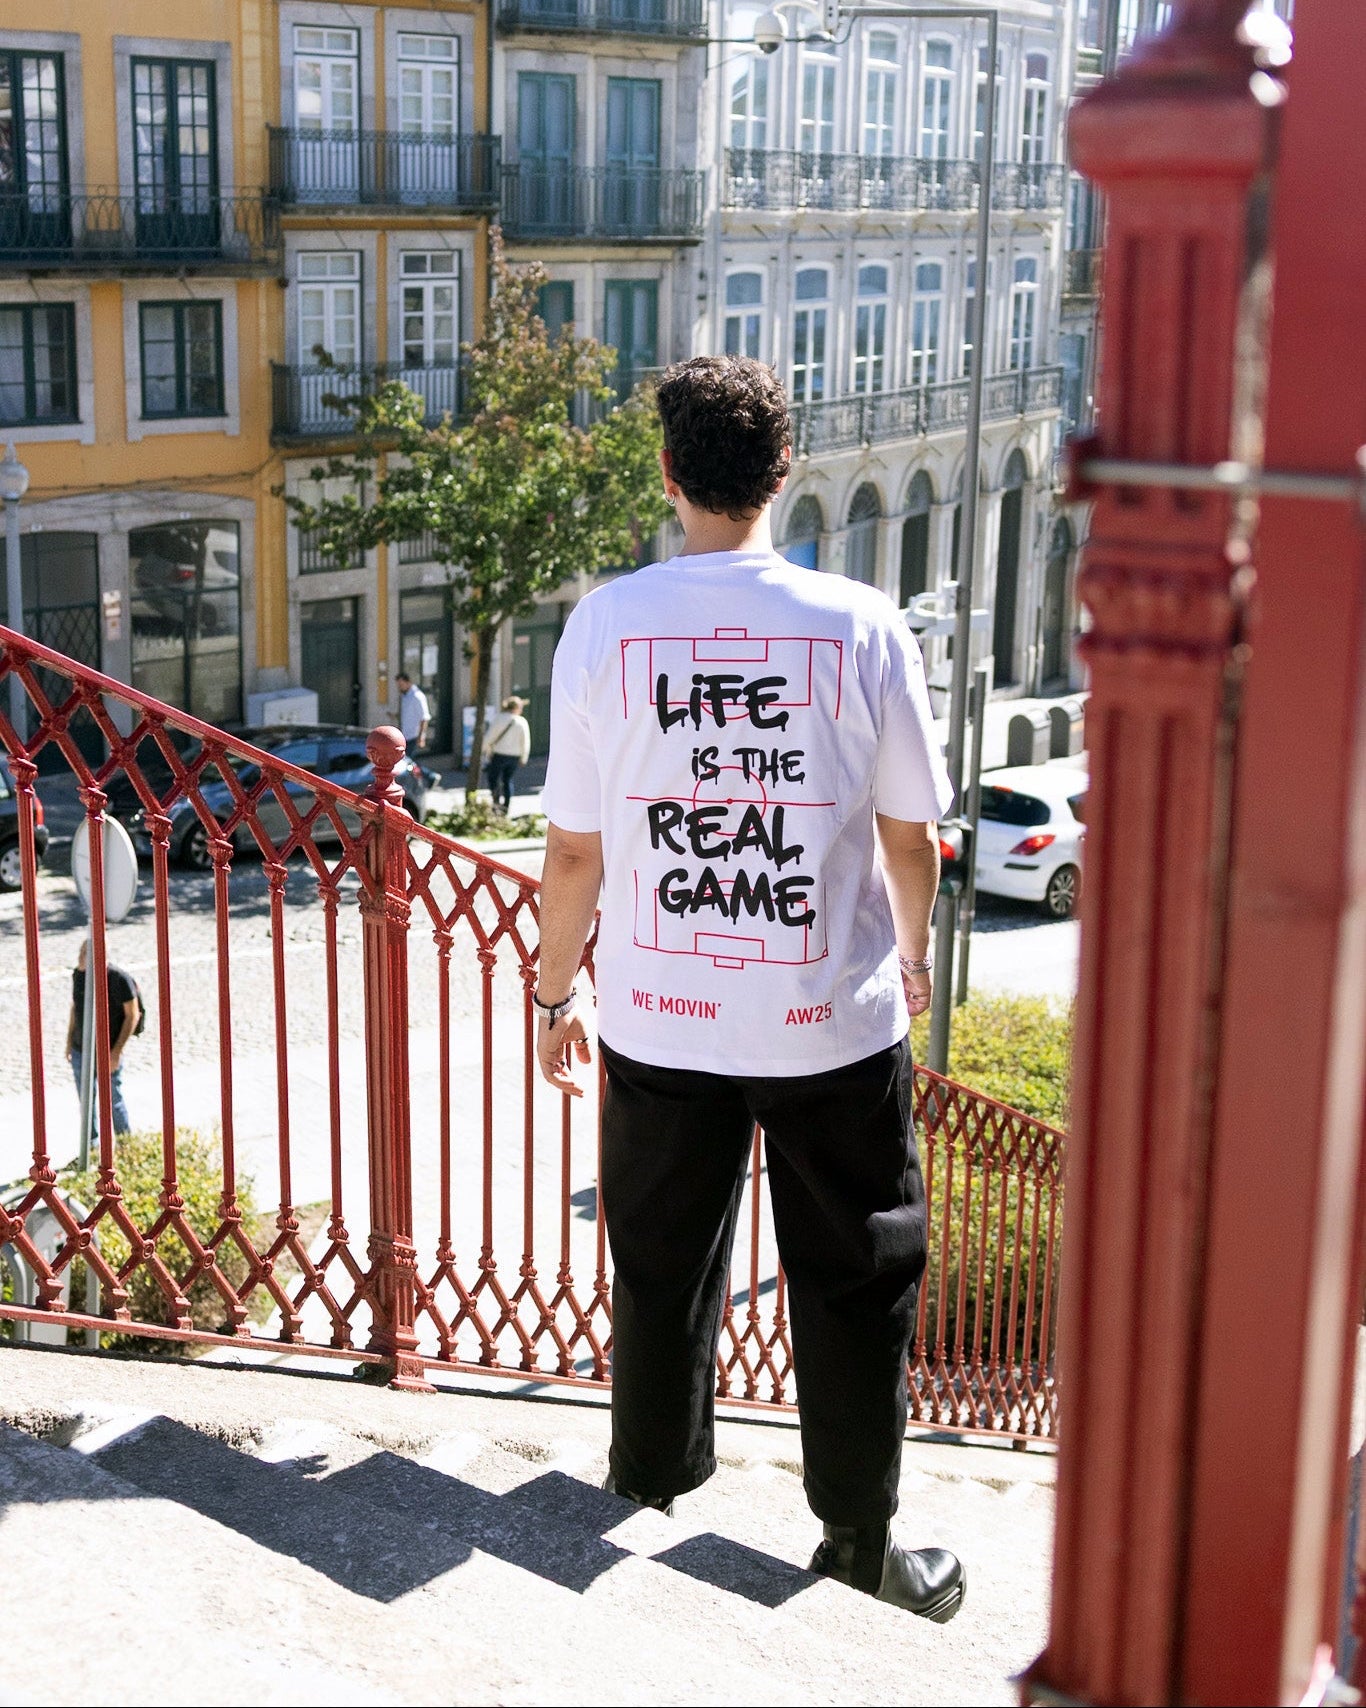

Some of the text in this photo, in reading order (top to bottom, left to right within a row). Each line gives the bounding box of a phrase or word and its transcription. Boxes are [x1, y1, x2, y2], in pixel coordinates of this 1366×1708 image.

[732, 747, 805, 789] THE
[647, 801, 804, 872] REAL
[659, 866, 816, 930] GAME
[632, 988, 654, 1011] WE
[785, 1001, 832, 1025] AW25
